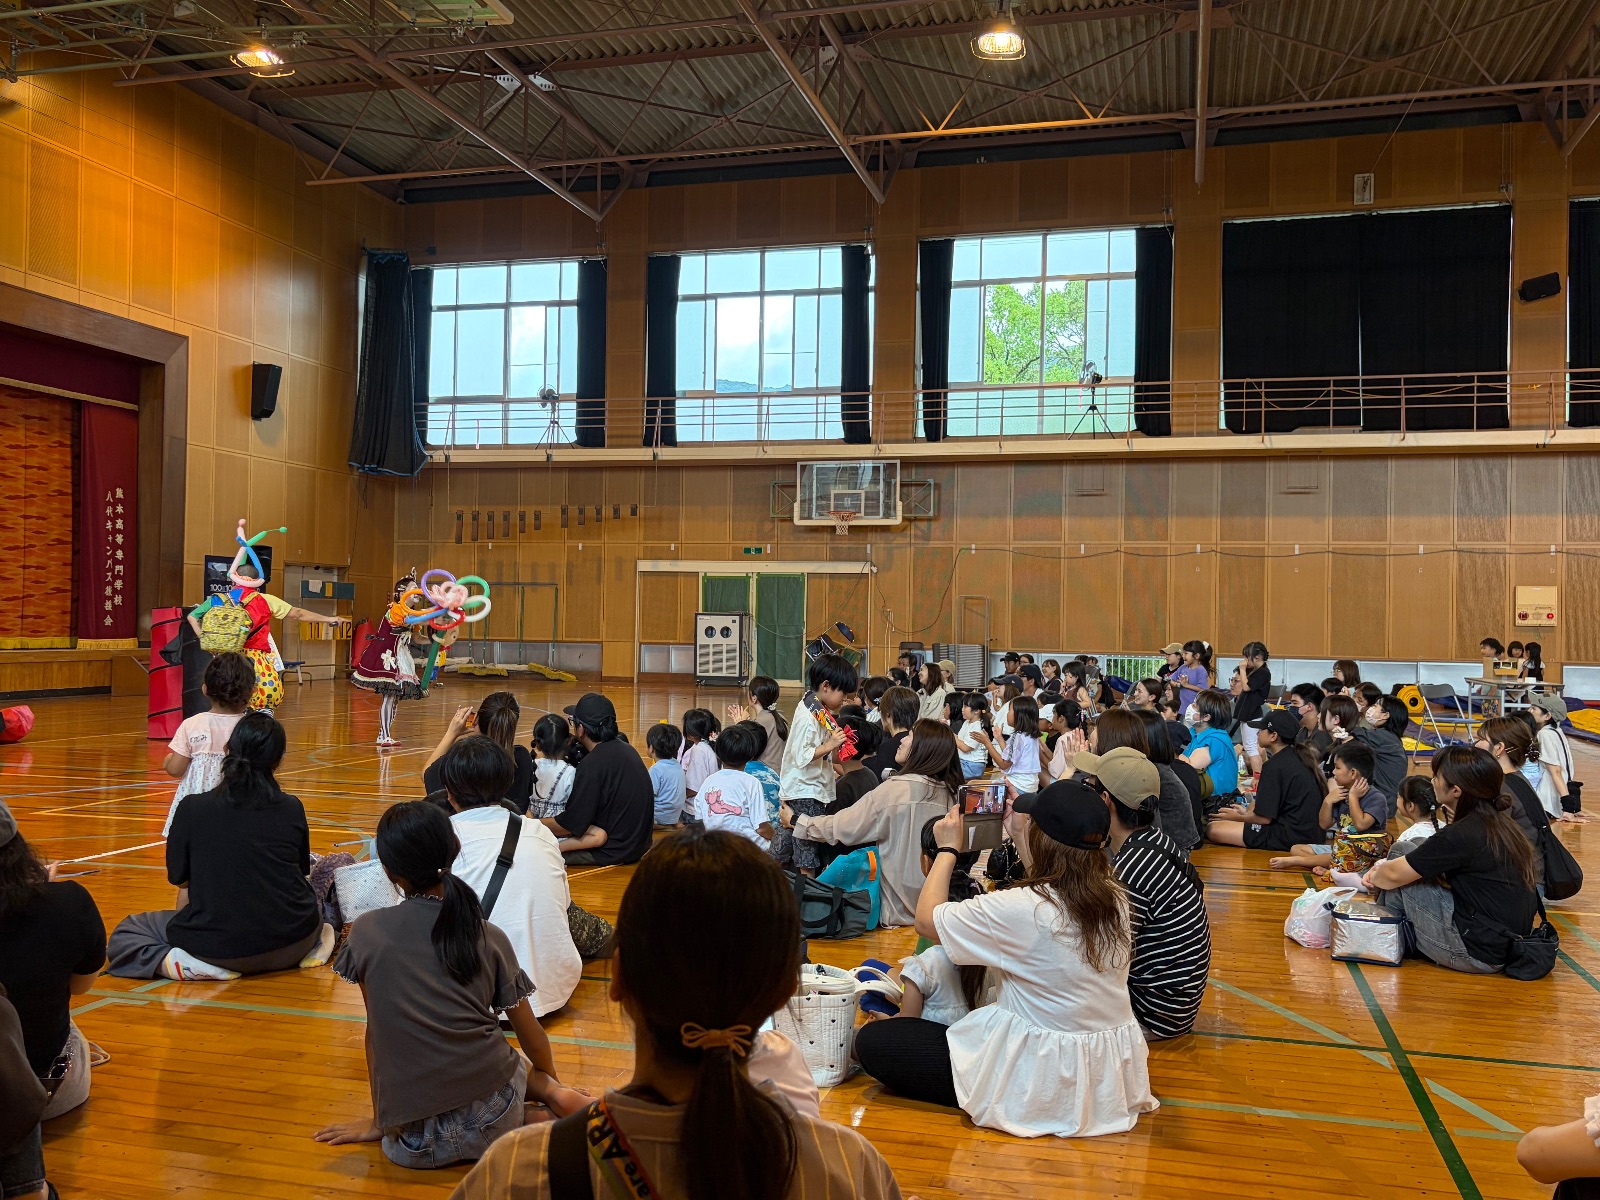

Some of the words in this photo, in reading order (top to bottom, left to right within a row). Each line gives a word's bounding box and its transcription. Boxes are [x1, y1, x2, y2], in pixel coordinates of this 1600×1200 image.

[113, 487, 125, 606] 熊本高等専門学校
